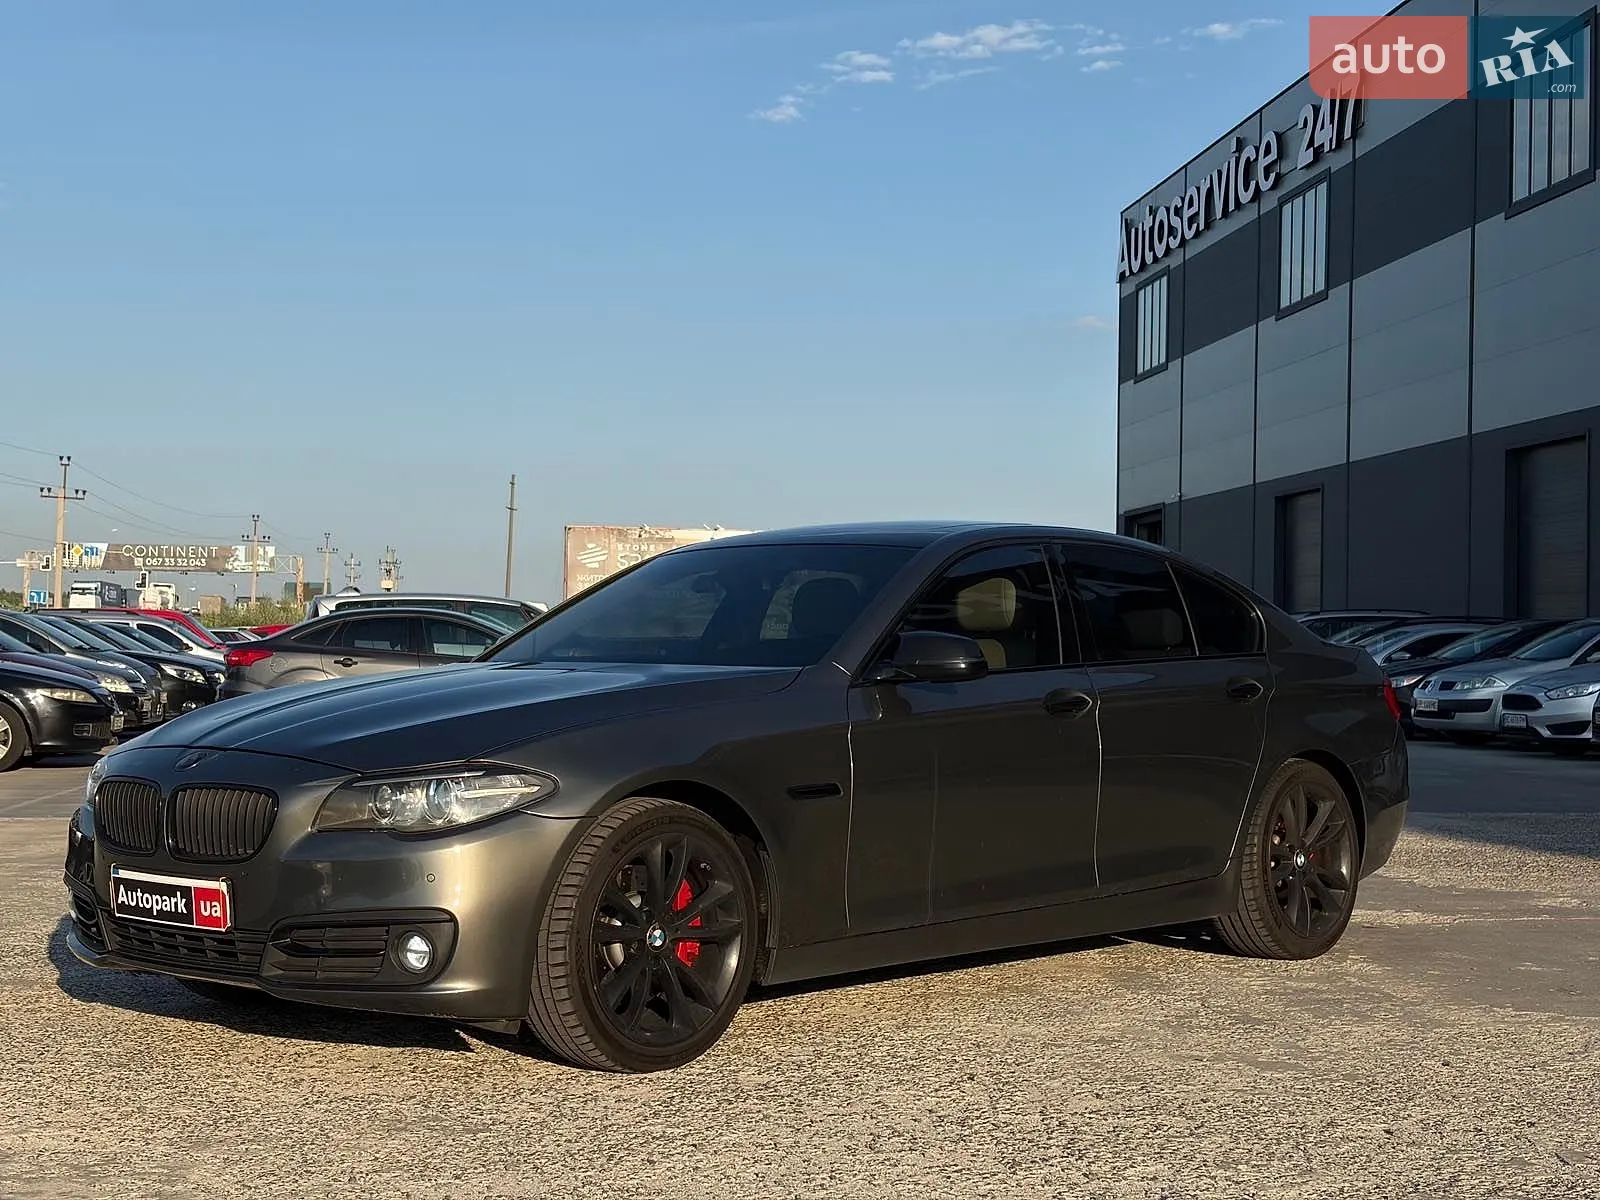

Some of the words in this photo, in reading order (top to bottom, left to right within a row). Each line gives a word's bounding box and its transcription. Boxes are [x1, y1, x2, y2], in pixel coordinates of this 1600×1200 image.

[1118, 131, 1279, 279] Autoservice
[1297, 68, 1363, 170] 24/7
[122, 544, 219, 559] CONTINENT
[145, 558, 164, 567] 067
[164, 558, 176, 567] 33
[176, 558, 188, 567] 32
[117, 883, 188, 916] Autopark
[199, 899, 221, 918] ua
